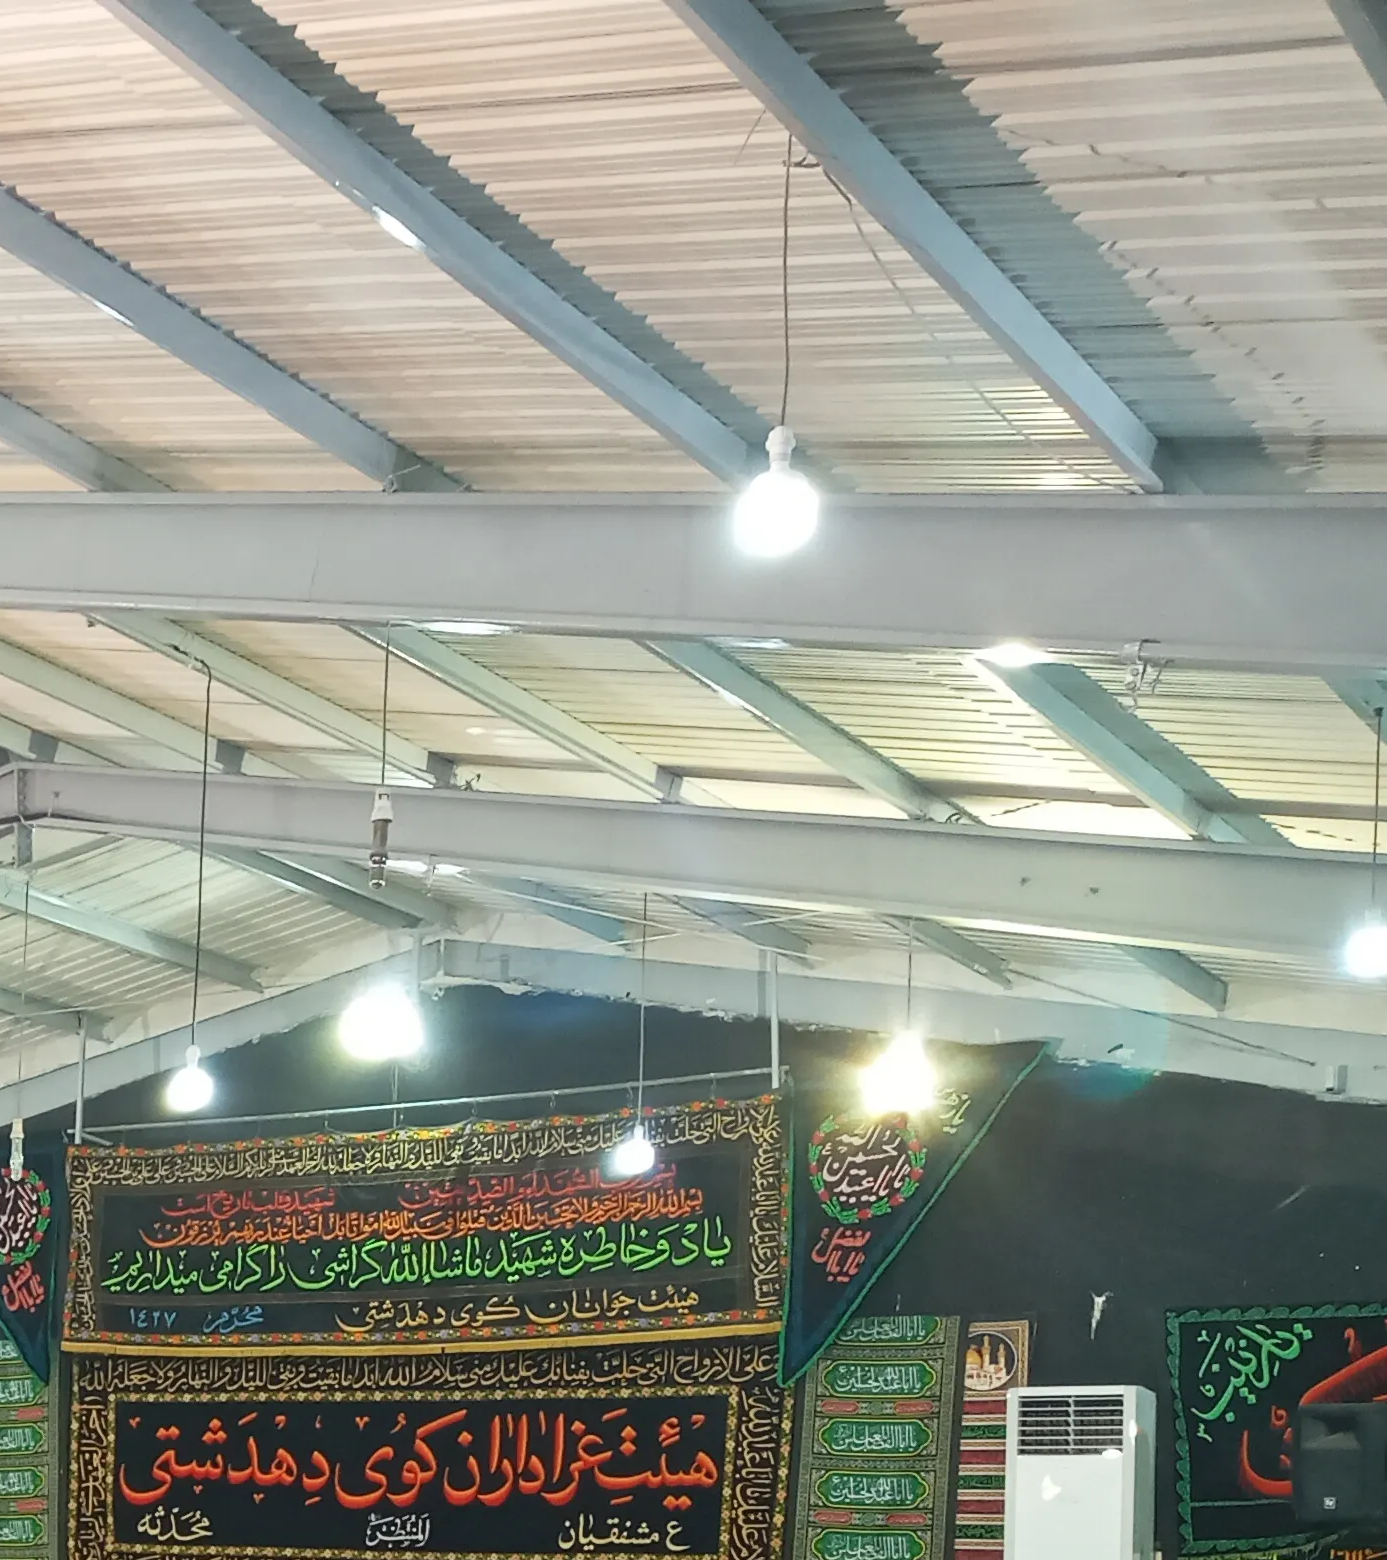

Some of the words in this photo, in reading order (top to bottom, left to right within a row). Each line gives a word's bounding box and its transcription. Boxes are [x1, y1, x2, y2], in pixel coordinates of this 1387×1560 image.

[485, 1232, 557, 1281] شهید
[673, 1215, 731, 1267] یاد
[202, 1304, 263, 1333] محرم
[450, 1292, 521, 1328] کوی
[525, 1287, 637, 1325] جوانان
[379, 1357, 415, 1387] الله
[119, 1416, 329, 1506] دهدشتی
[335, 1410, 467, 1508] کوی
[136, 1507, 214, 1541] محدثه
[558, 1513, 660, 1550] مشفقیان
